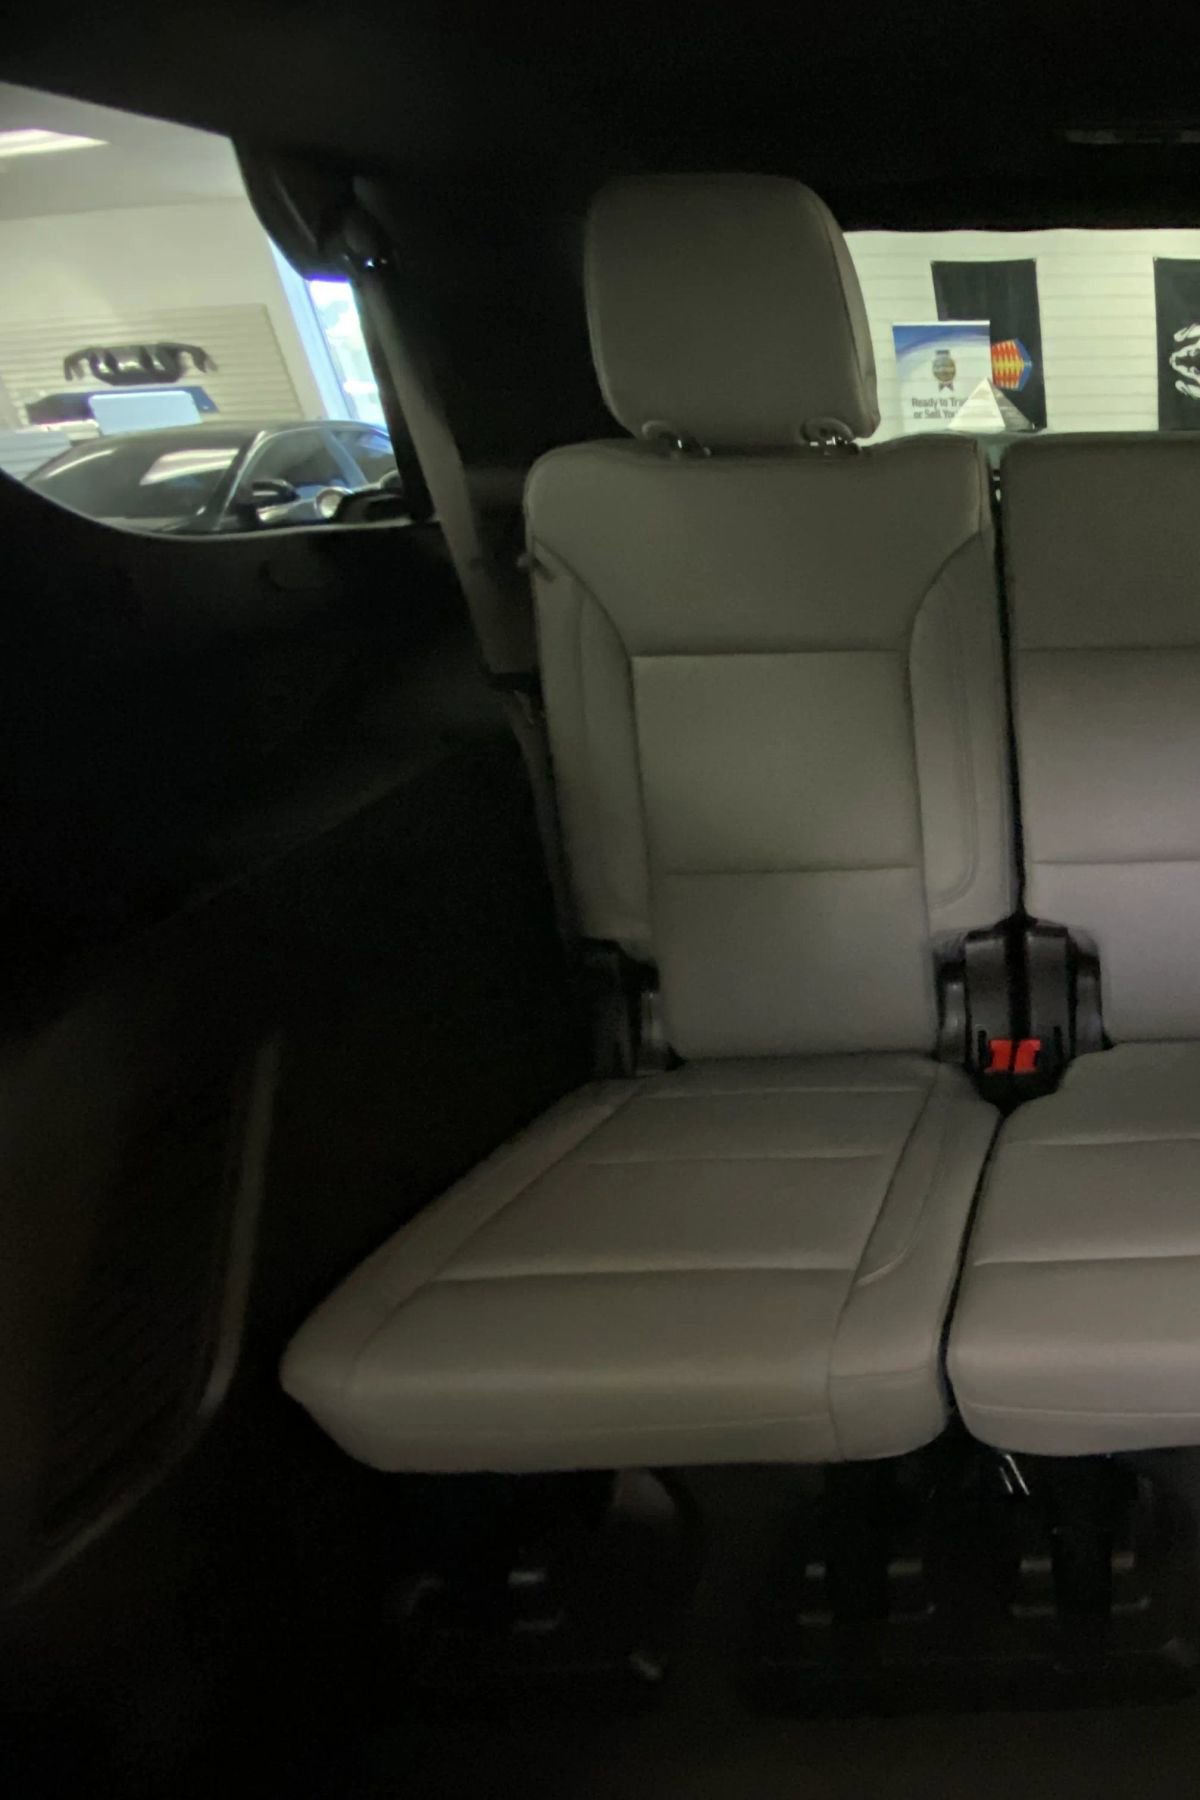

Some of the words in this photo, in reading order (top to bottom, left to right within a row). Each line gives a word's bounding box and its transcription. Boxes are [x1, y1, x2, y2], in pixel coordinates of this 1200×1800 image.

[911, 397, 938, 411] Ready
[939, 398, 948, 408] to
[913, 411, 922, 419] or
[924, 409, 941, 419] Sell
